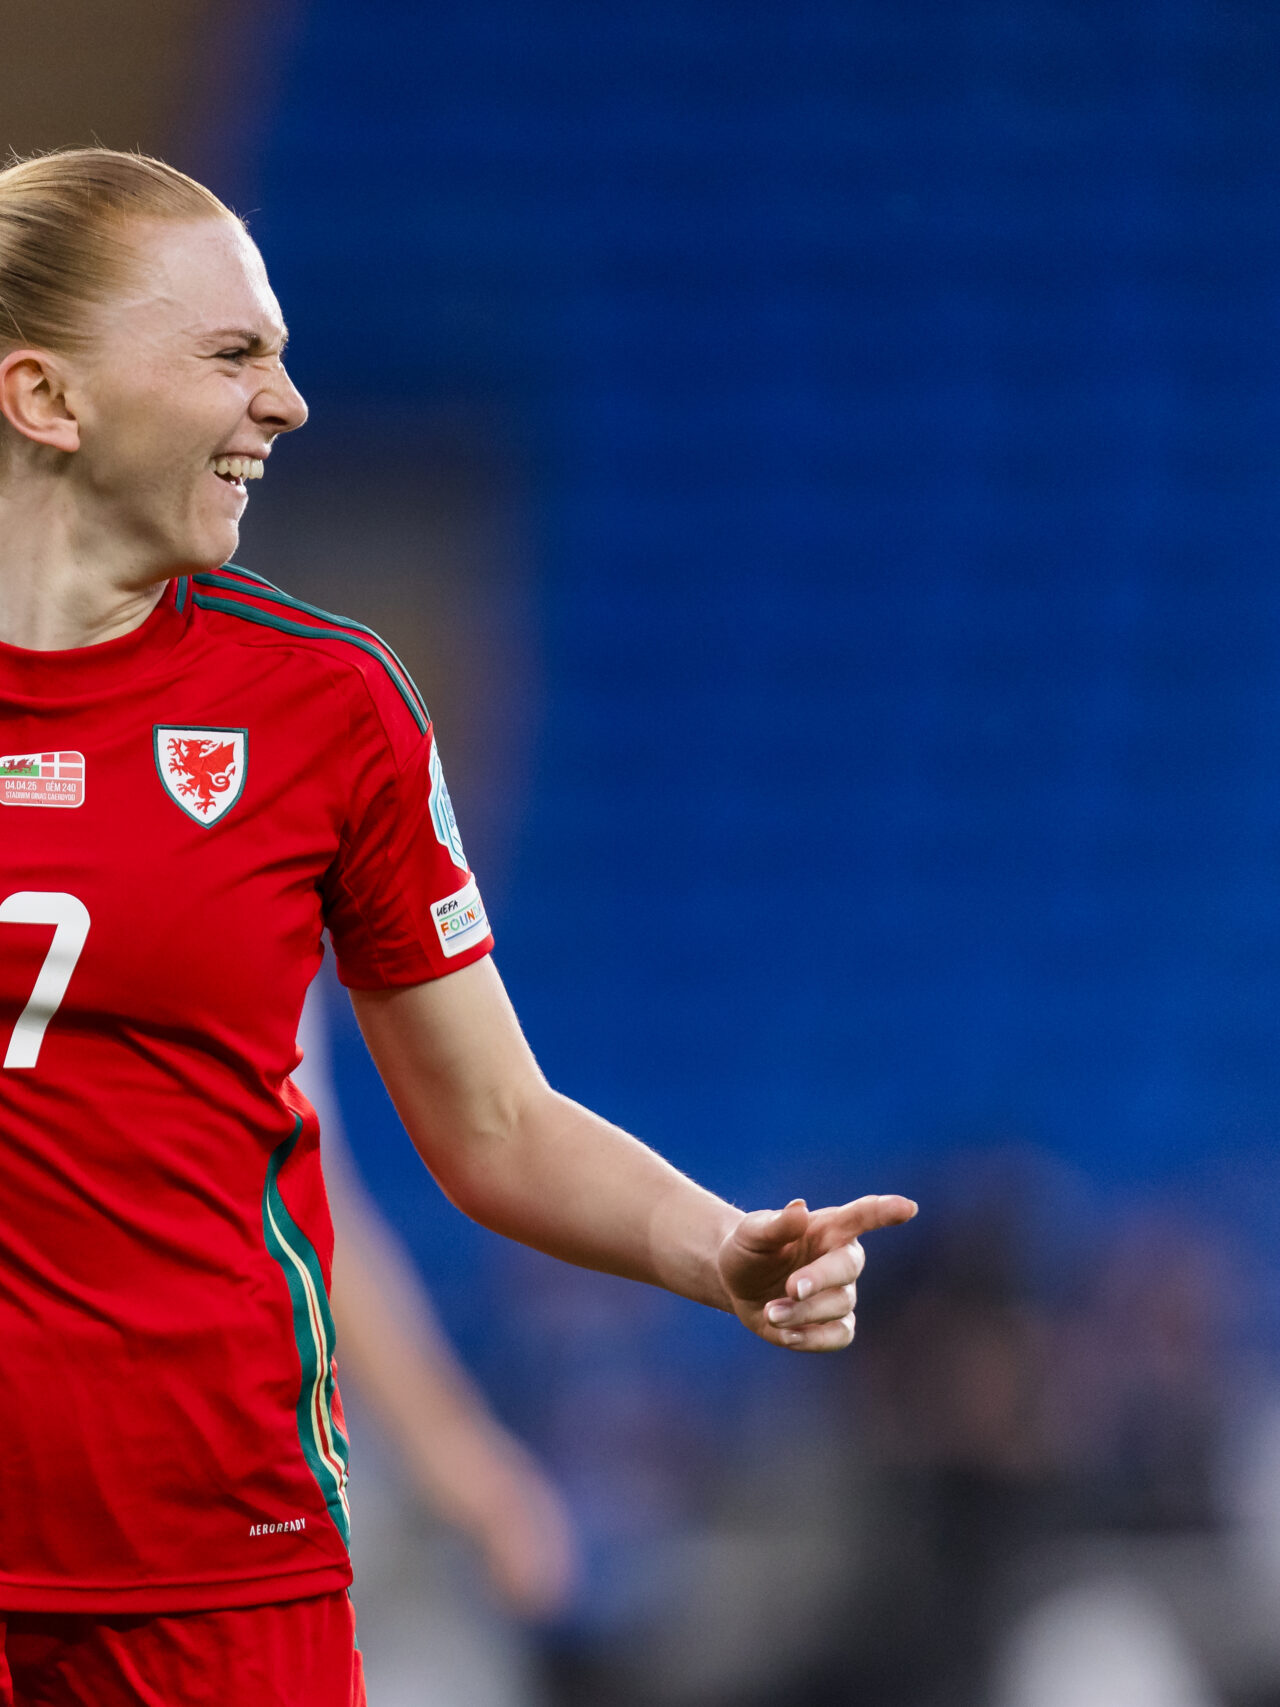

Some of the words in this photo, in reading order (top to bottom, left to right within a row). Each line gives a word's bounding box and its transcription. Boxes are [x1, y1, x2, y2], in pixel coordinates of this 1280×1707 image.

[5, 780, 37, 791] 04.04.25
[62, 783, 77, 793] 240
[437, 899, 459, 917] UEFA
[249, 1517, 306, 1536] AEROREADY
